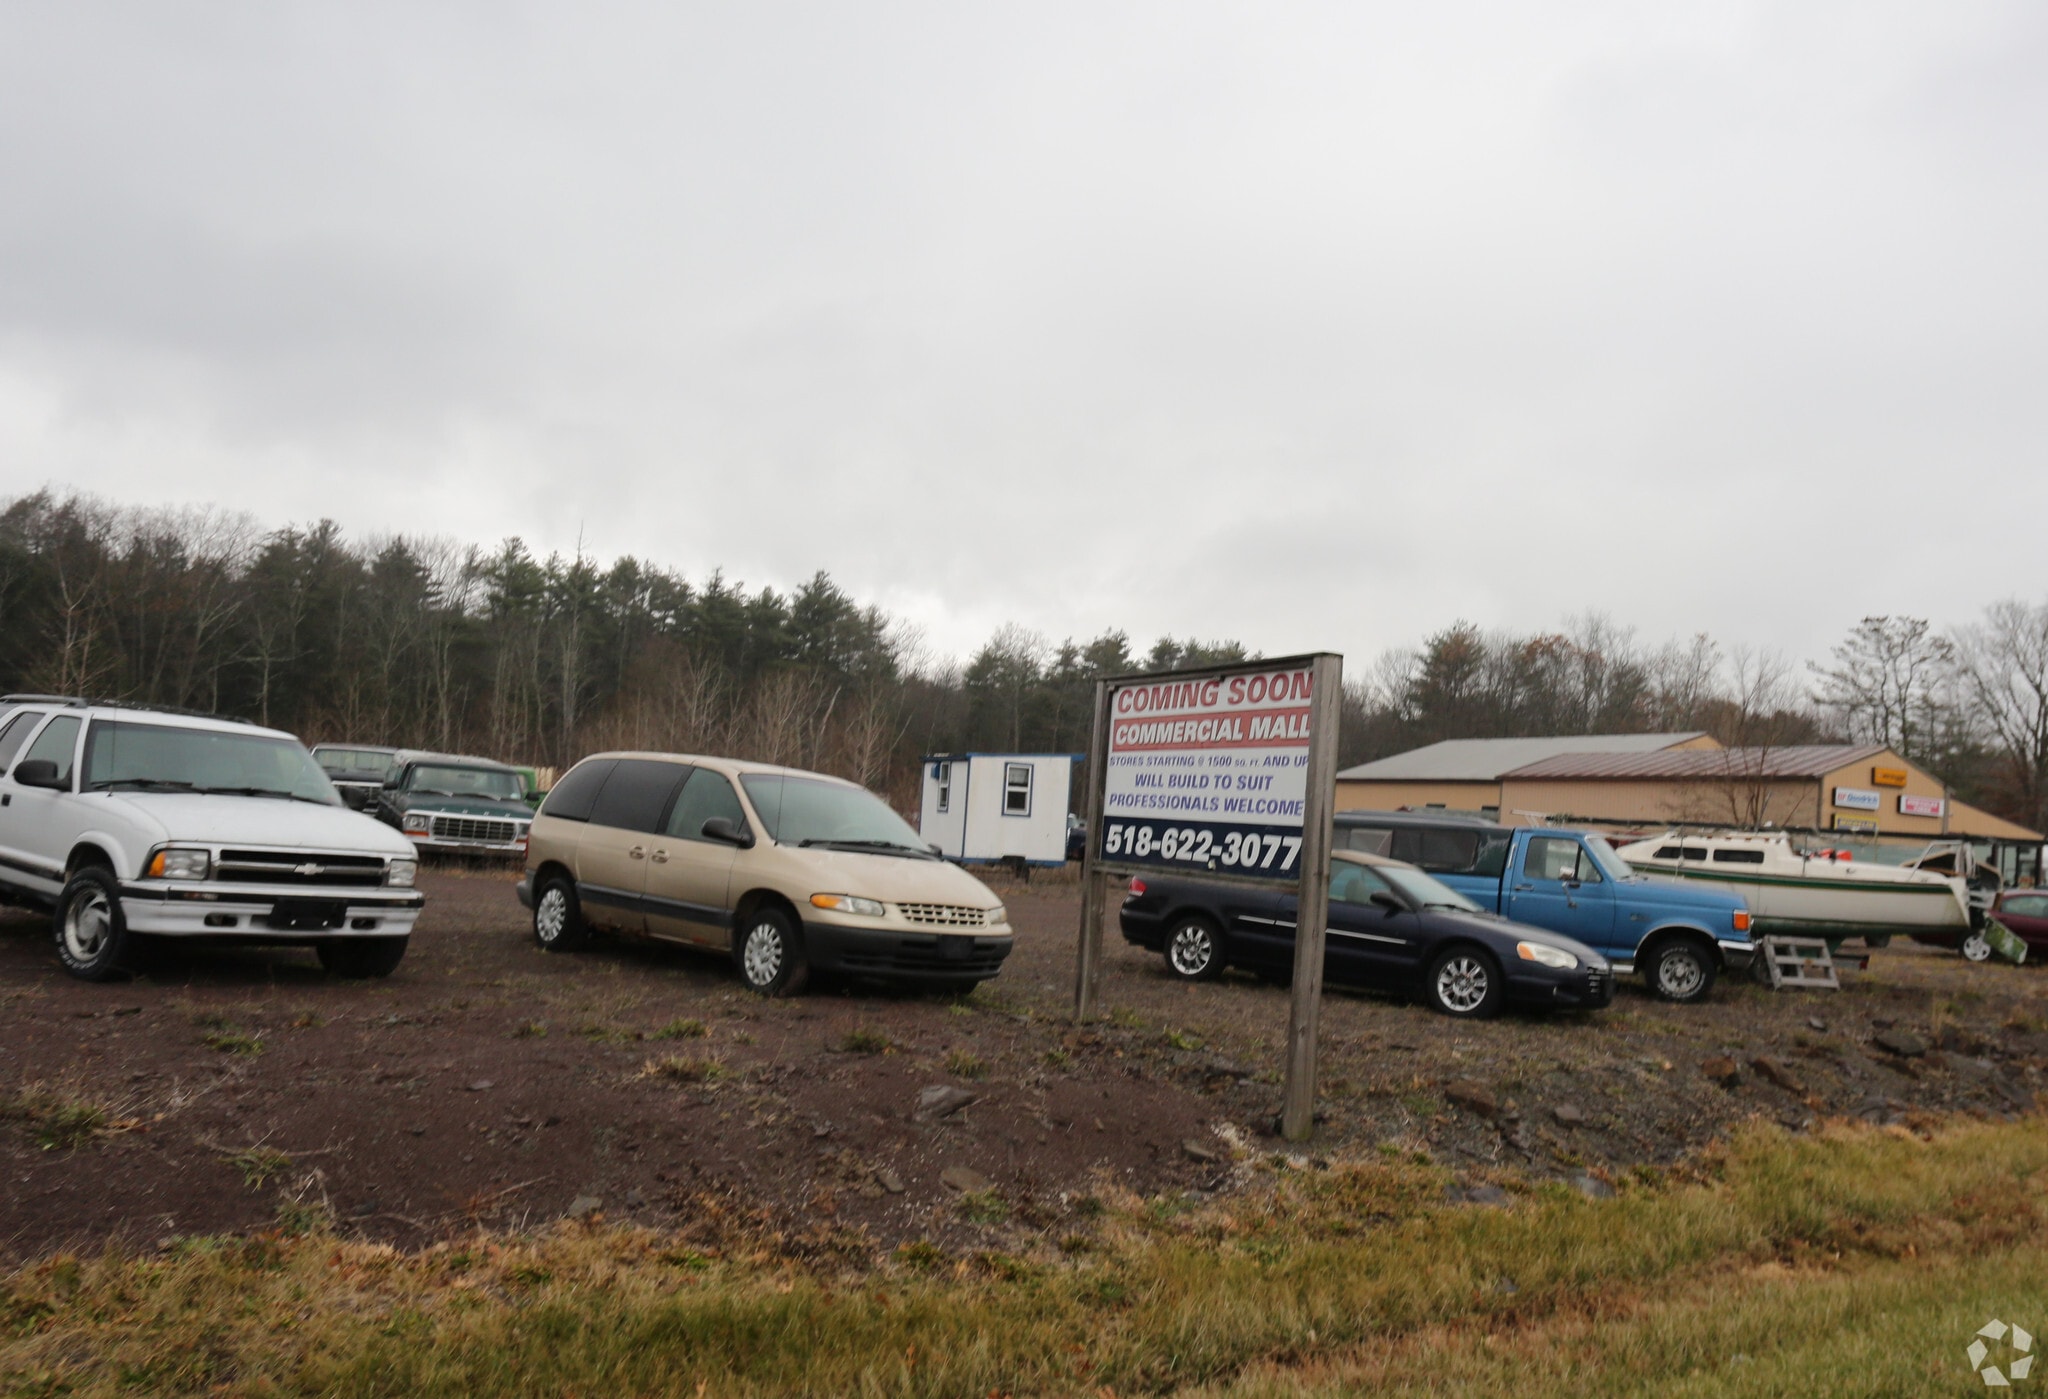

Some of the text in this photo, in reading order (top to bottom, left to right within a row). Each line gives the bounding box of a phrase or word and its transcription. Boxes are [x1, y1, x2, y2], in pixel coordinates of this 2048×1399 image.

[1118, 671, 1313, 713] COMING SOON
[1115, 713, 1310, 746] COMMERCIAL MALL
[1109, 755, 1144, 767] STORES
[1146, 755, 1195, 767] STARTING
[1207, 755, 1232, 767] 1500
[1263, 755, 1290, 768] AND
[1135, 773, 1273, 791] WILL BUILD TO SUIT
[1109, 793, 1304, 817] PROFESSIONALS WELCOME
[1106, 823, 1303, 871] 518-622-3077
